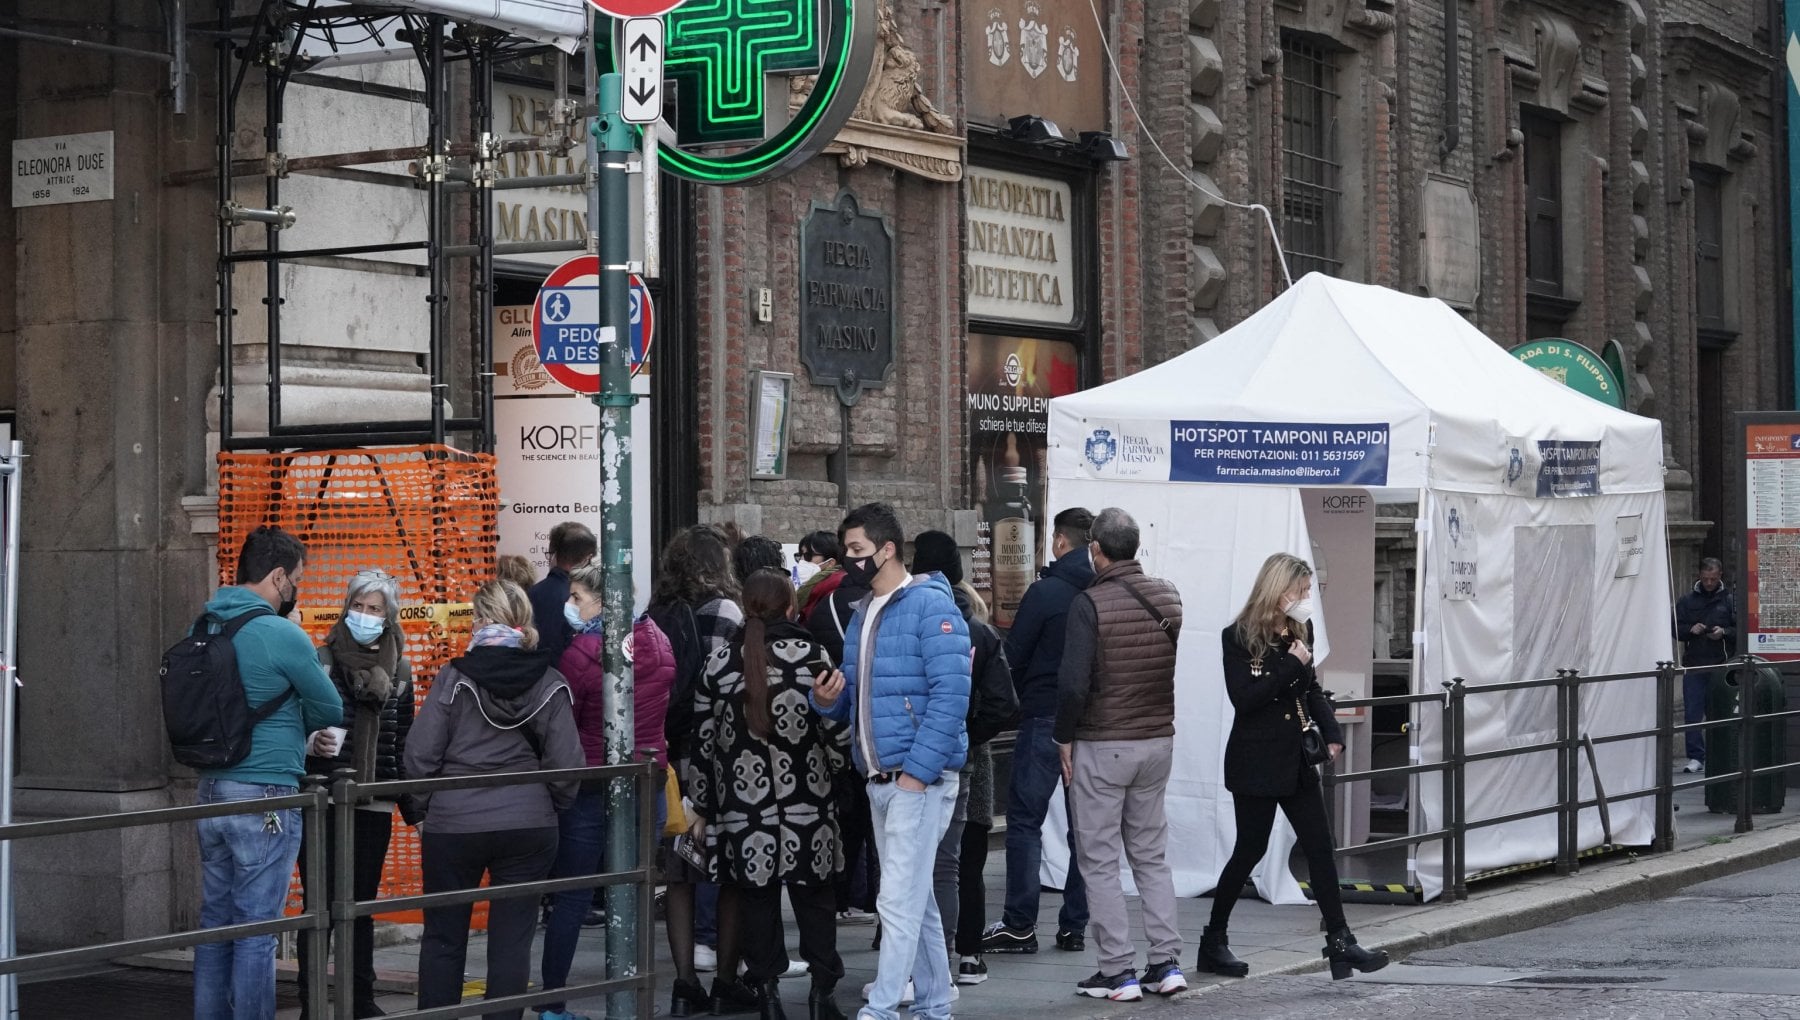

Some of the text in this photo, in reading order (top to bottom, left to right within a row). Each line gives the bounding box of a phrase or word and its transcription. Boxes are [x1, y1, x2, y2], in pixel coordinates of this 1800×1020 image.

[55, 142, 67, 150] VIA
[17, 153, 104, 177] ELEONORA DUSE
[46, 175, 75, 185] ATTRICE
[32, 186, 90, 199] 1858 1924
[968, 219, 1057, 263] NFANZIA
[823, 240, 871, 269] REGIA
[808, 280, 887, 312] FARMACIA
[818, 324, 878, 351] MASINO
[546, 346, 557, 360] A
[1548, 346, 1560, 355] DI
[1563, 348, 1573, 359] S.
[980, 416, 1046, 434] schiera le tue difese
[1123, 435, 1149, 445] REGIA
[1174, 428, 1387, 445] HOTSPOT TAMPONI RAPIDI
[1122, 445, 1164, 455] FARMACIA
[1194, 449, 1365, 461] PER PRENOTAZIONI: 011 5631569
[1122, 453, 1156, 463] MASINO
[513, 502, 600, 513] Giornata Bea
[1323, 495, 1367, 508] KORFF
[1001, 544, 1026, 554] IMMUNO
[996, 554, 1031, 566] SUPPLEMENT
[400, 606, 434, 620] CORSO
